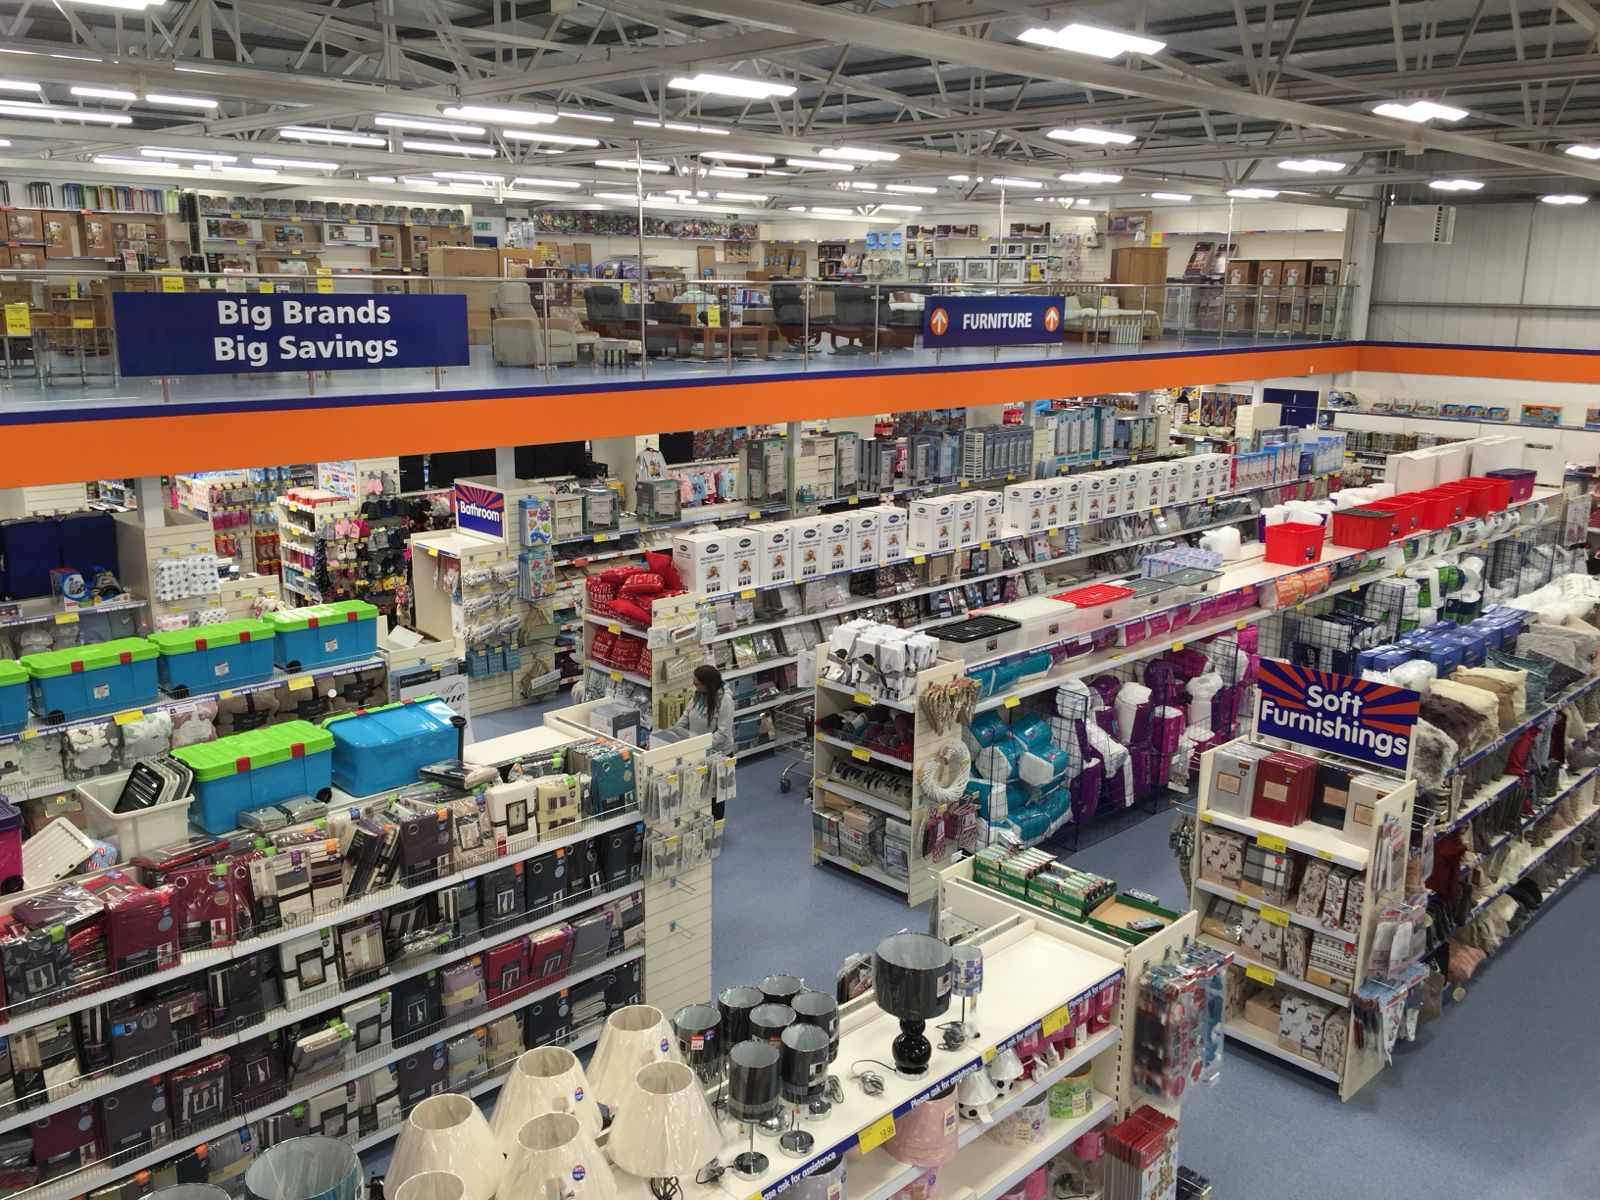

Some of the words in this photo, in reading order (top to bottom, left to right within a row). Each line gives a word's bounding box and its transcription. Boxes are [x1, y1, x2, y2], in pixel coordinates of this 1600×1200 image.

[217, 300, 273, 331] Big
[282, 299, 391, 325] Brands
[963, 312, 1033, 330] FURNITURE
[214, 335, 269, 367] Big
[278, 333, 400, 364] Savings
[459, 500, 500, 523] Bathroom
[1307, 685, 1363, 717] Soft
[1261, 700, 1408, 758] Furnishings
[1068, 996, 1082, 1008] Please
[1083, 990, 1092, 999] ask
[1099, 974, 1120, 990] assistance
[1007, 1037, 1016, 1047] ask
[1016, 1032, 1024, 1042] for
[911, 1092, 930, 1110] Please
[930, 1082, 942, 1096] ask
[940, 1075, 952, 1088] for
[952, 1062, 978, 1083] assistance
[880, 1126, 894, 1140] 19.99
[778, 1177, 791, 1194] ask
[791, 1170, 802, 1185] for
[802, 1151, 836, 1178] assistance
